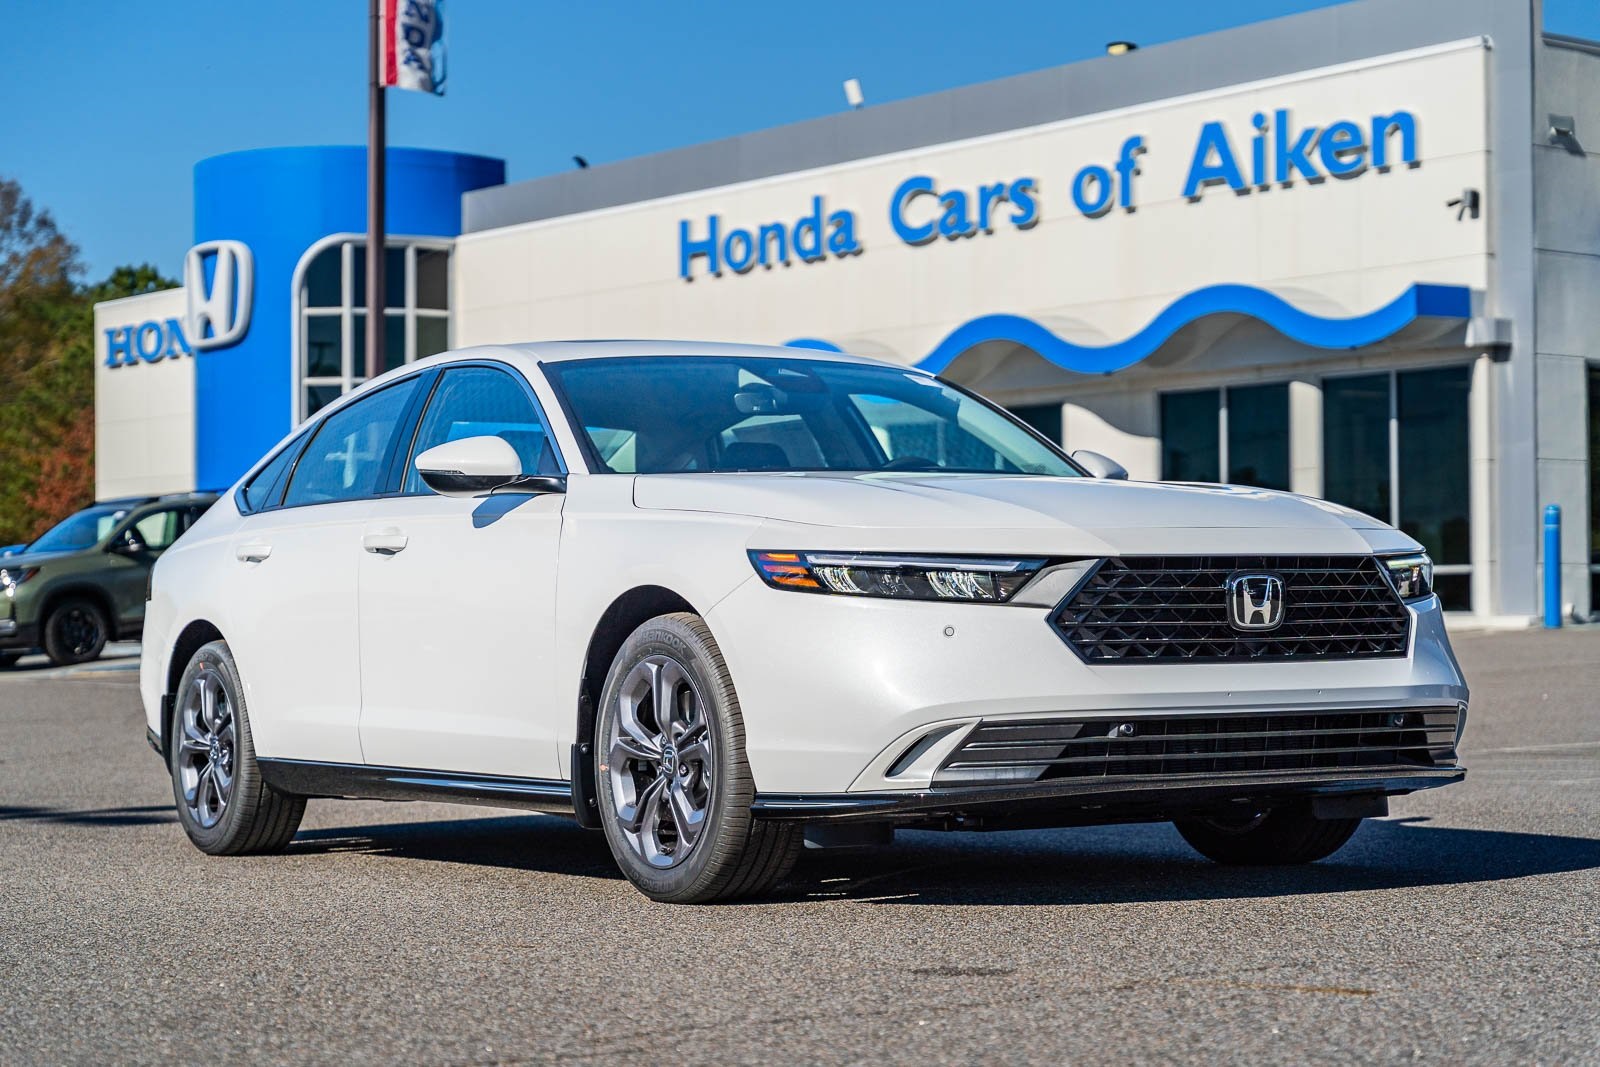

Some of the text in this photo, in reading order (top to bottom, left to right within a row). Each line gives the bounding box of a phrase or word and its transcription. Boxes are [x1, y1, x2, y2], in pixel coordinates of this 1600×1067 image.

[679, 108, 1417, 279] Honda Cars of Aiken
